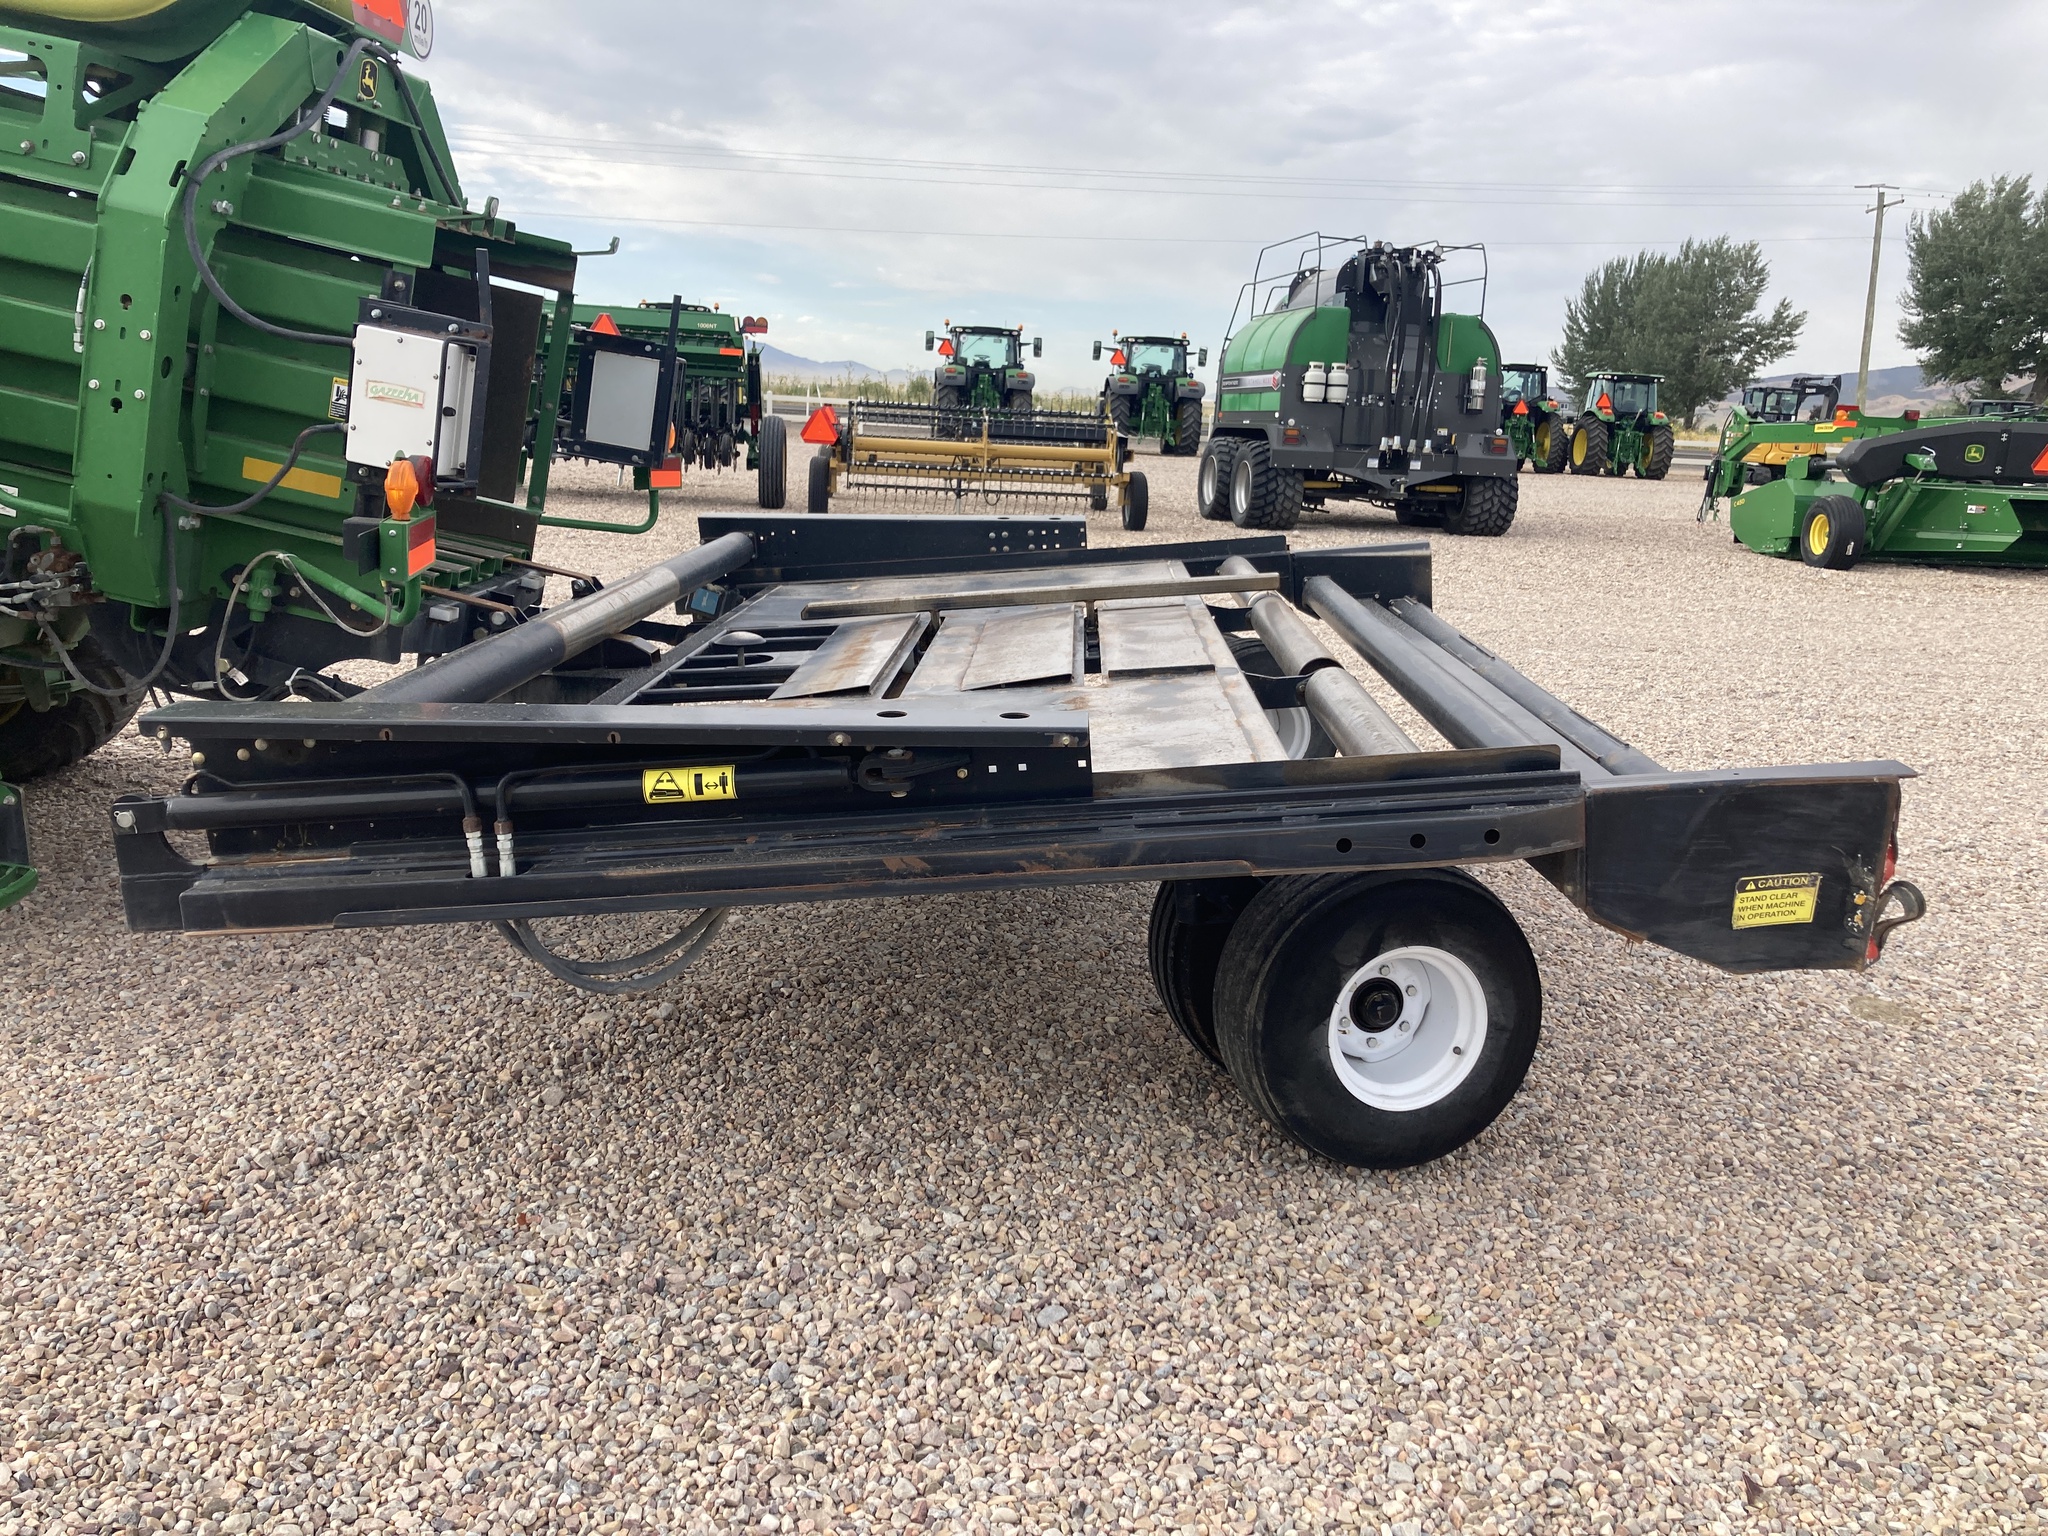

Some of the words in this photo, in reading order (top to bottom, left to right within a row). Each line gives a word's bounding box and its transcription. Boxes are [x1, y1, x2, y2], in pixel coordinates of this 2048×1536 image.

[415, 0, 427, 34] 20
[1757, 876, 1809, 888] CAUTION
[1739, 894, 1768, 904] STAND
[1769, 892, 1798, 901] CLEAR
[1737, 904, 1764, 912] WHEN
[1765, 900, 1806, 910] MACHINE
[1747, 910, 1797, 920] OPERATION
